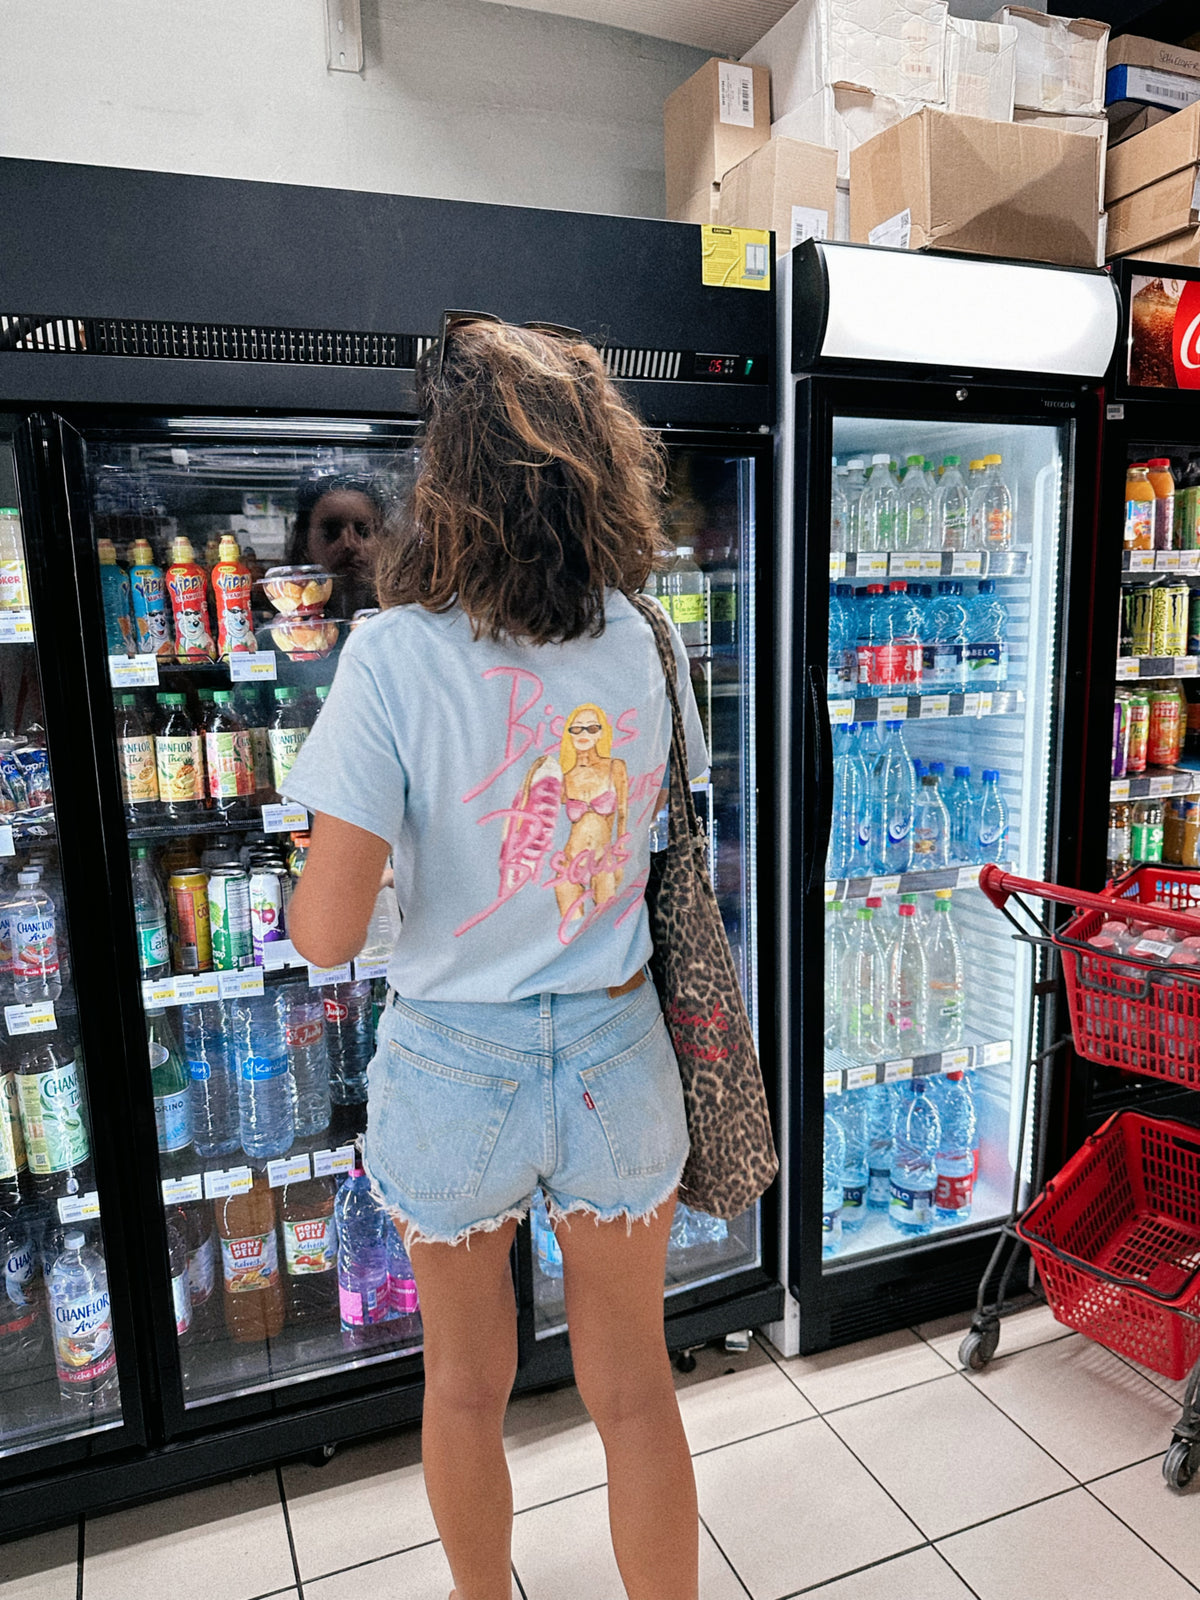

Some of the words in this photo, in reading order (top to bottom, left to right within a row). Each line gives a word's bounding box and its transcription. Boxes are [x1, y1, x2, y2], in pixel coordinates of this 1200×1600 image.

[135, 576, 164, 597] Yipp
[297, 1222, 324, 1232] MONT
[232, 1240, 261, 1251] MONT
[56, 1291, 110, 1323] CHANFLOR
